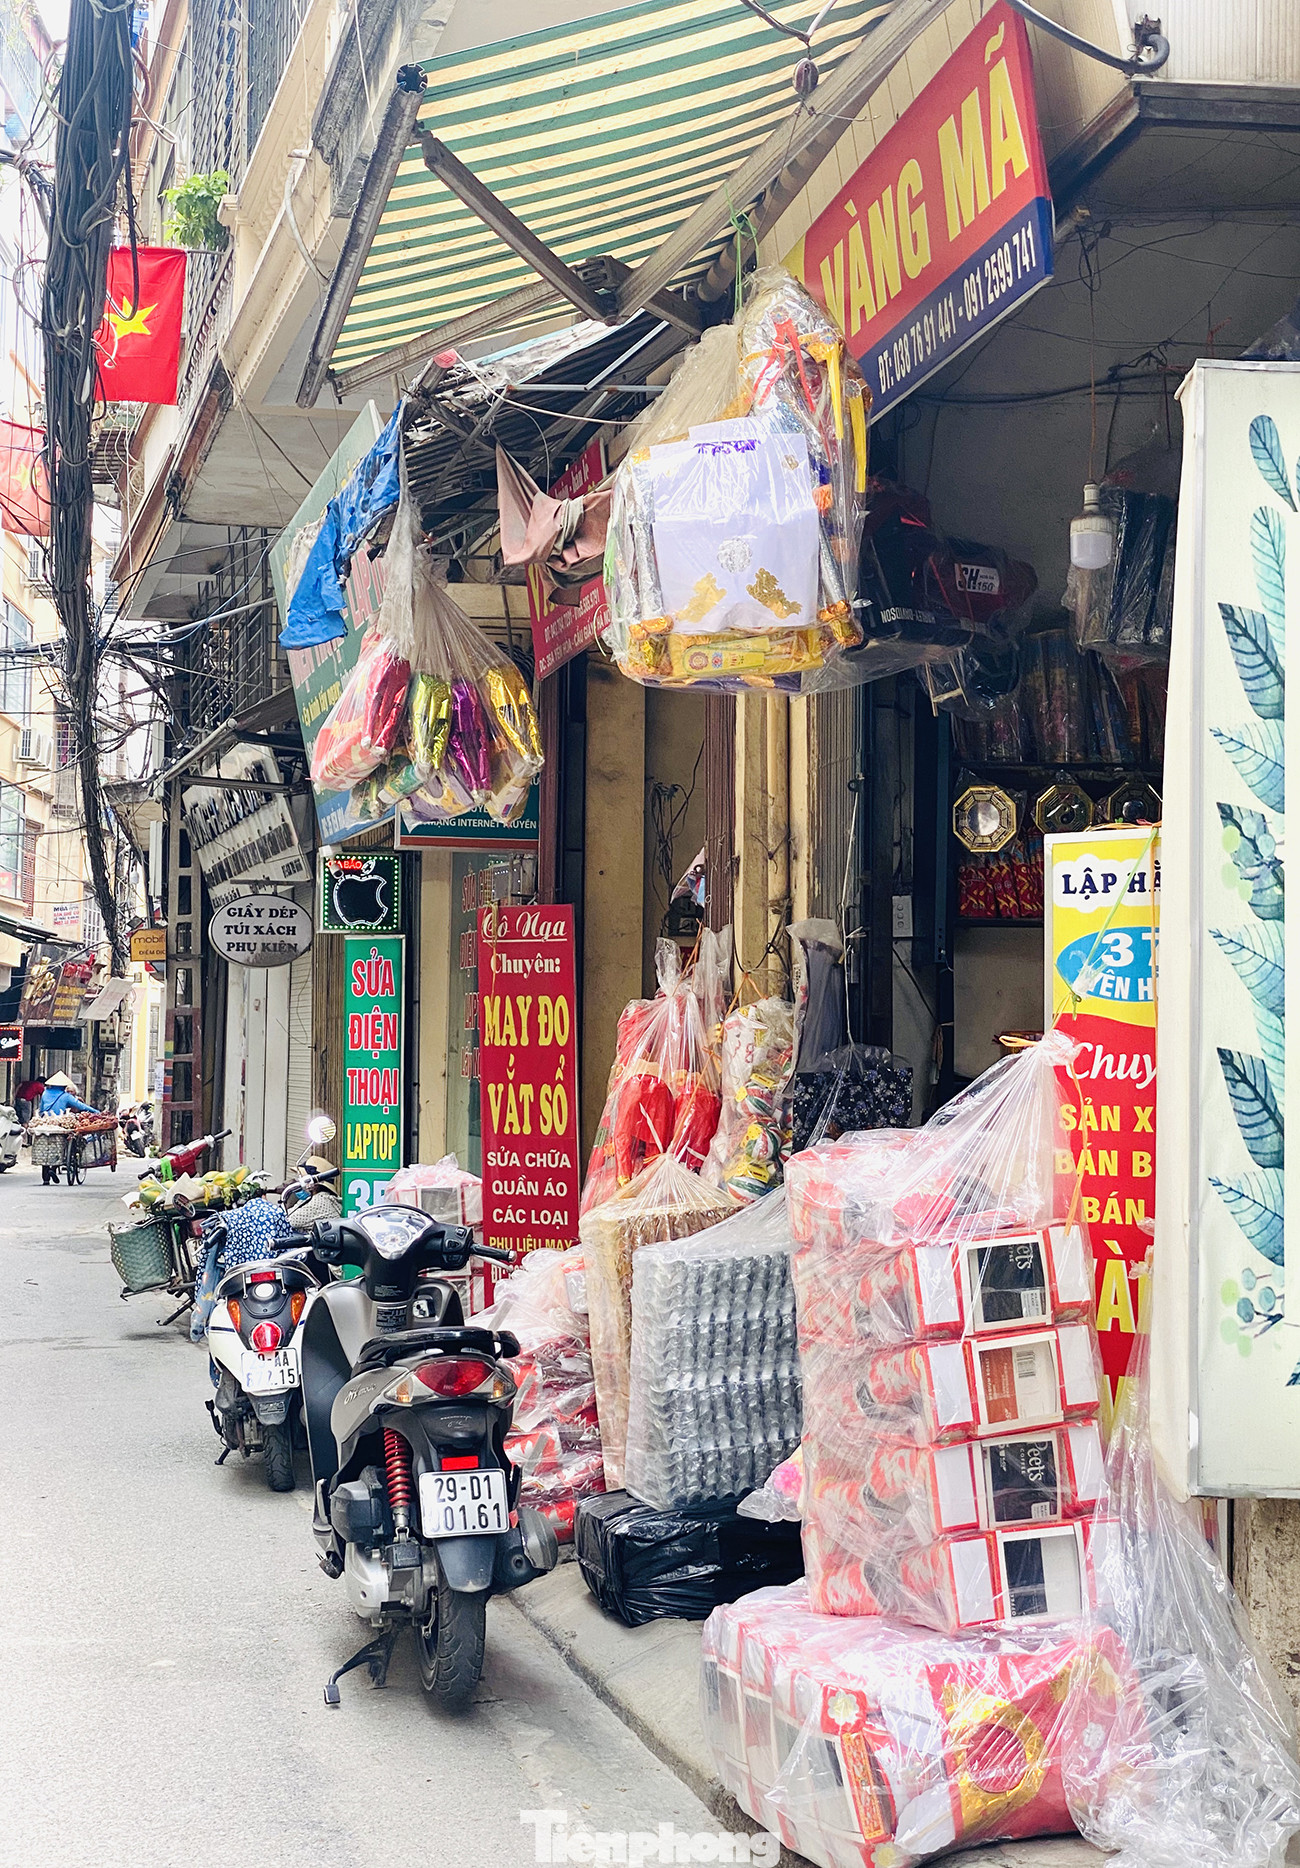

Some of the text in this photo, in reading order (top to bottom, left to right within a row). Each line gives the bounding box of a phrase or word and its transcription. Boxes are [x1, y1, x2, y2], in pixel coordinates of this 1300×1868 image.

[820, 21, 1029, 338] VÀNG MÃ
[878, 349, 893, 394] ĐT:
[893, 333, 911, 381] 038
[910, 321, 923, 366] 76
[923, 309, 936, 356] 91
[938, 292, 957, 343] 441
[963, 266, 985, 321] 091
[984, 242, 1013, 304] 2599
[1012, 221, 1036, 279] 741
[1062, 867, 1117, 900] LẬP
[227, 903, 298, 918] GIẦY DÉP
[224, 922, 296, 936] TÚI XÁCH
[226, 942, 257, 955] PHỤ
[351, 947, 395, 997] SỬA
[491, 953, 560, 979] Chuyên:
[348, 1005, 398, 1059] ĐIỆN
[483, 995, 569, 1046] MAY ĐO
[347, 1068, 399, 1114] THOẠI
[487, 1053, 568, 1136] VẮT SỔ
[1060, 1098, 1120, 1132] SẢN
[346, 1123, 398, 1160] LAPTOP
[487, 1145, 571, 1169] SỬA CHỮA
[1055, 1143, 1118, 1177] BÁN
[492, 1174, 568, 1197] QUẦN ÁO
[492, 1204, 568, 1230] CÁC LOẠI
[1081, 1192, 1146, 1226] BÁN
[434, 1475, 493, 1503] 29-D1
